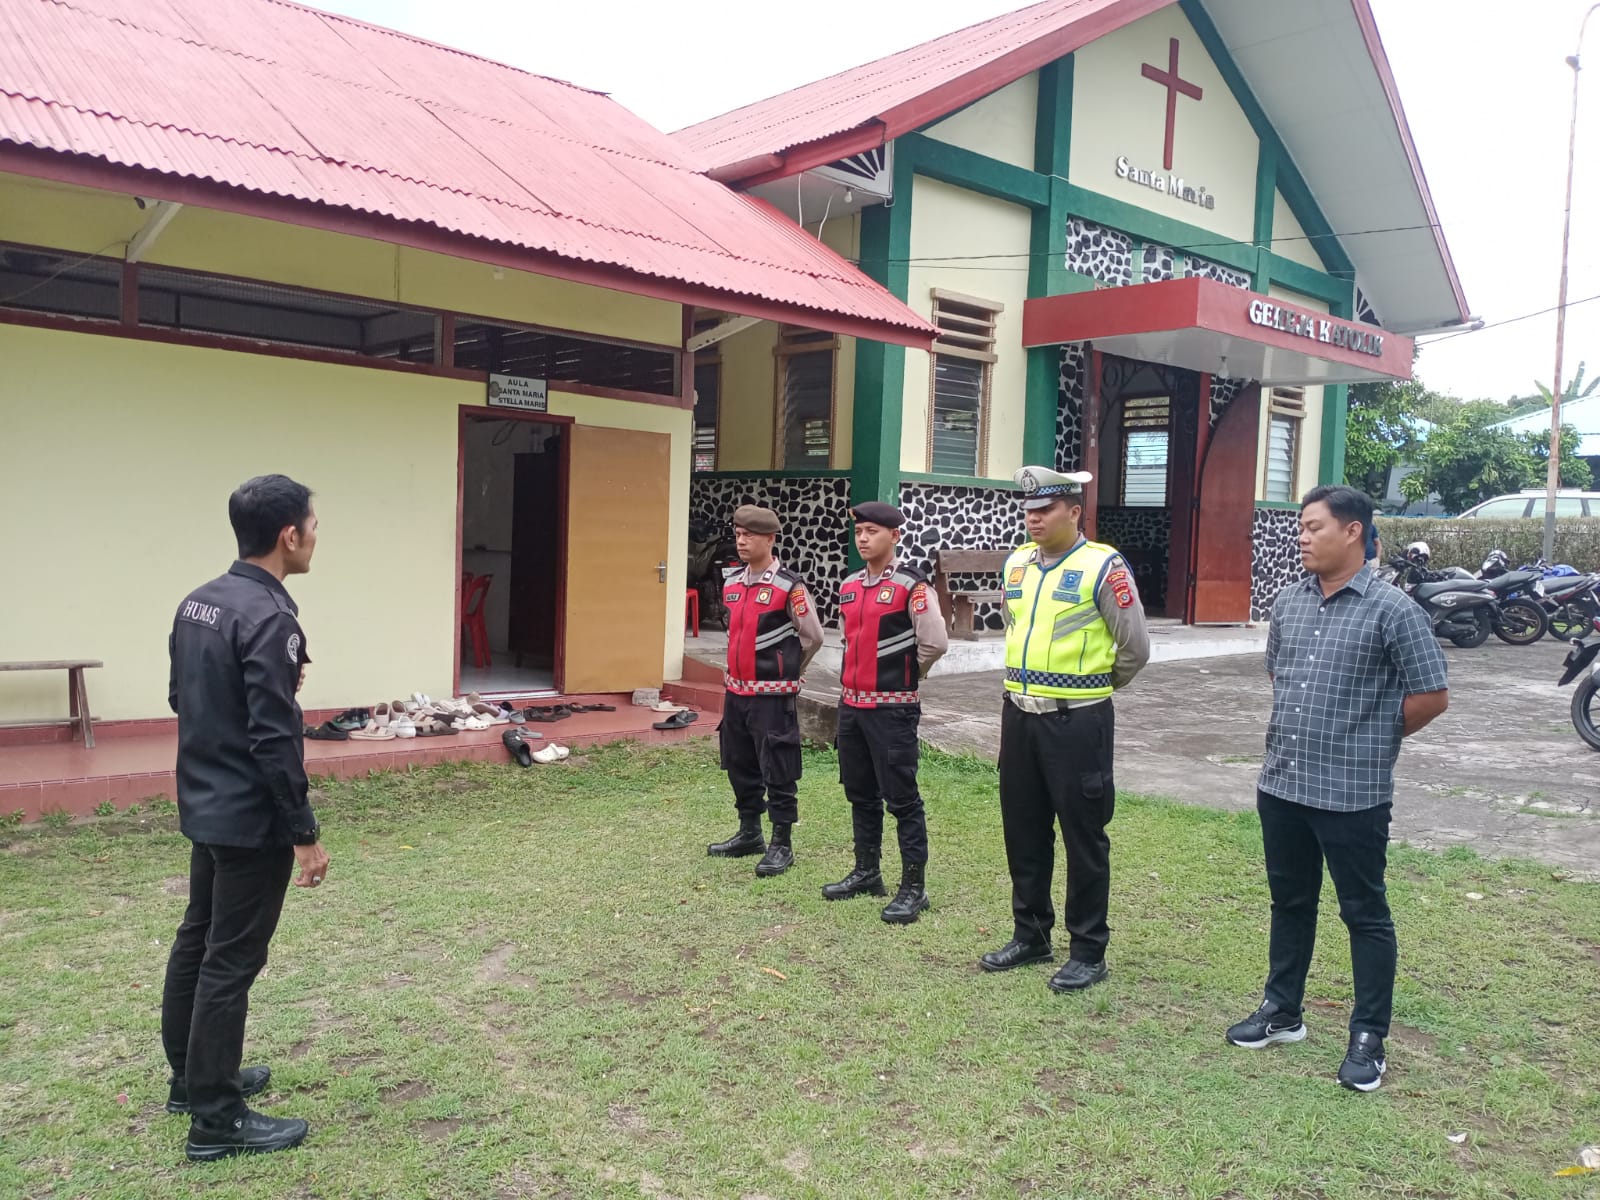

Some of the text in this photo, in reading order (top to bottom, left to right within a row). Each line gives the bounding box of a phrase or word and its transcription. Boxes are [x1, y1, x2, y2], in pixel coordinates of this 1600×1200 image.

[1116, 155, 1215, 210] Santa Maria
[1248, 298, 1384, 357] GEREJA KATOLIK
[507, 378, 529, 388] AULA
[498, 397, 545, 408] STELLA MARIS
[522, 390, 544, 399] MARIA
[182, 600, 220, 625] HUMAS
